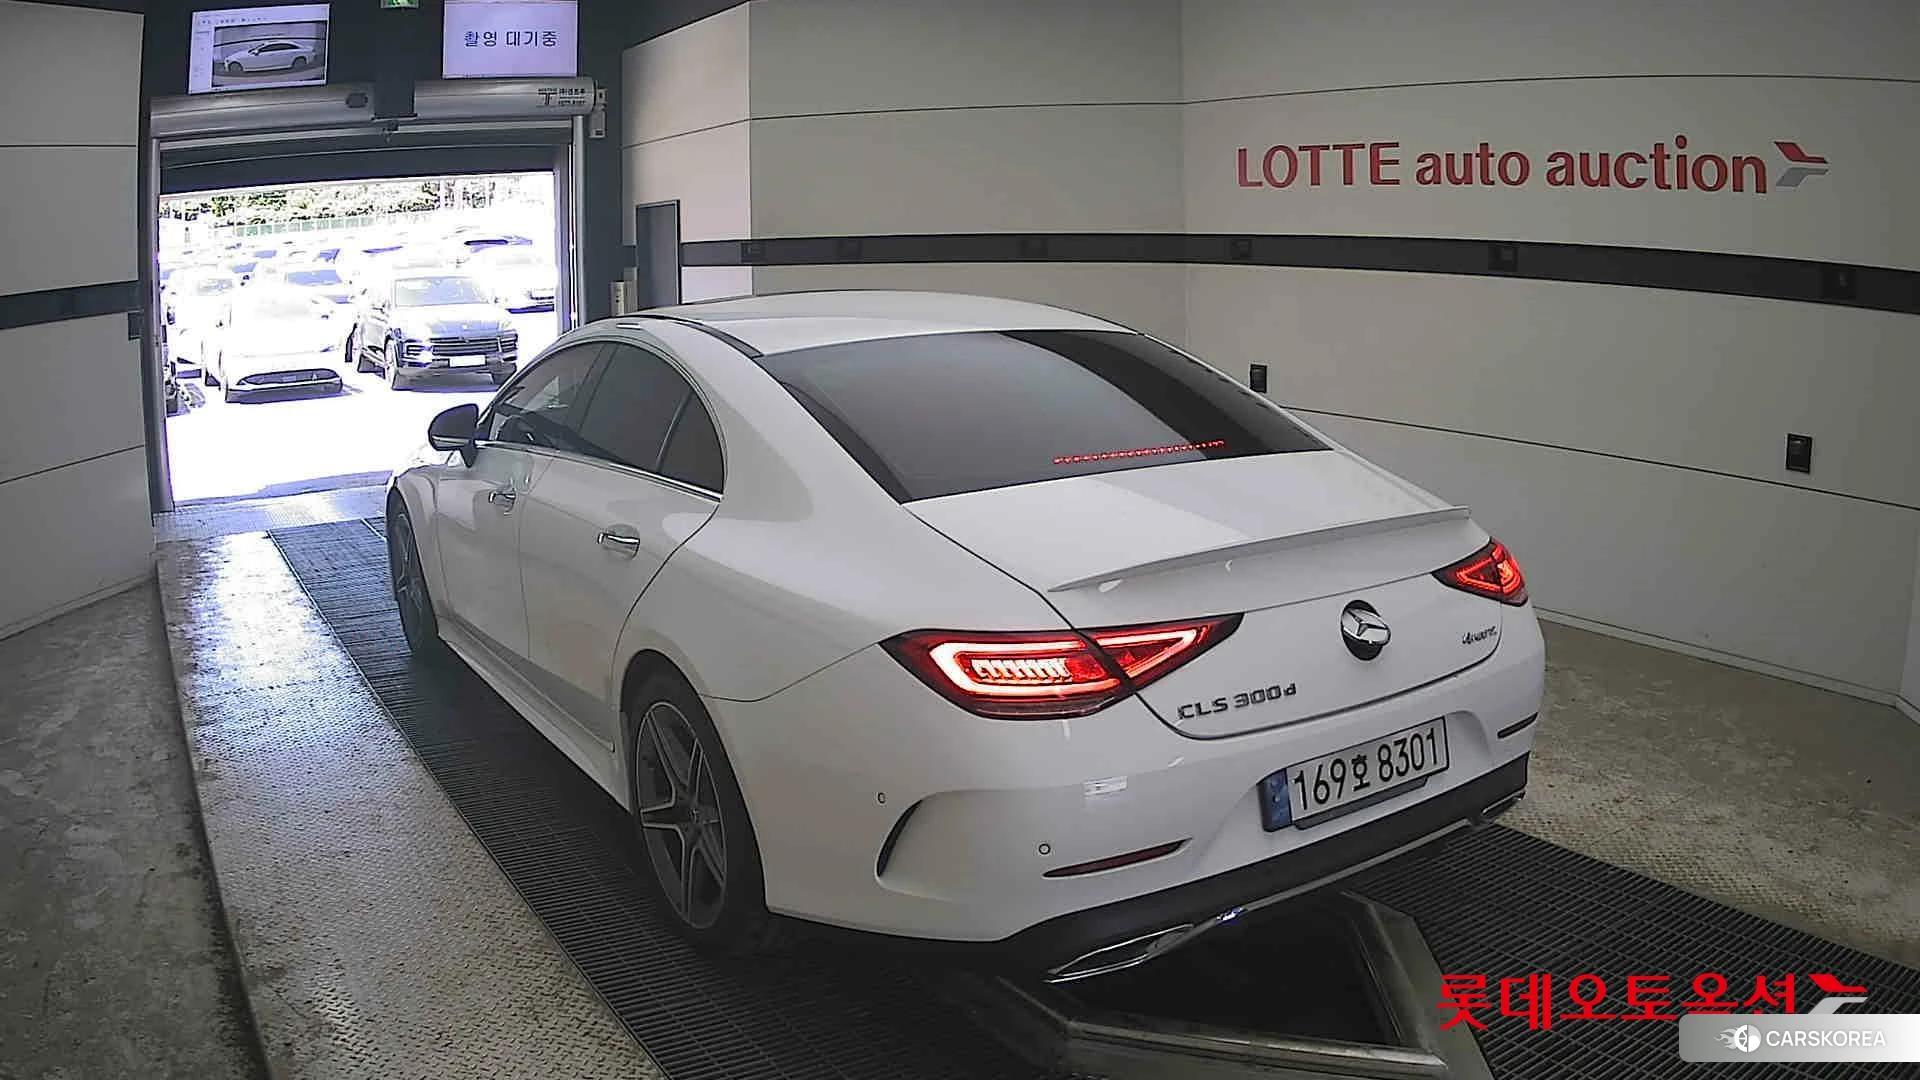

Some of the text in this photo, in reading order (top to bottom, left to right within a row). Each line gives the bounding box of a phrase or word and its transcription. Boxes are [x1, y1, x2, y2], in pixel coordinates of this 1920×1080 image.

[505, 30, 558, 47] 대기중
[1237, 134, 1767, 194] LOTTE auto auction
[1178, 697, 1228, 719] CLS
[1377, 728, 1439, 782] 8301
